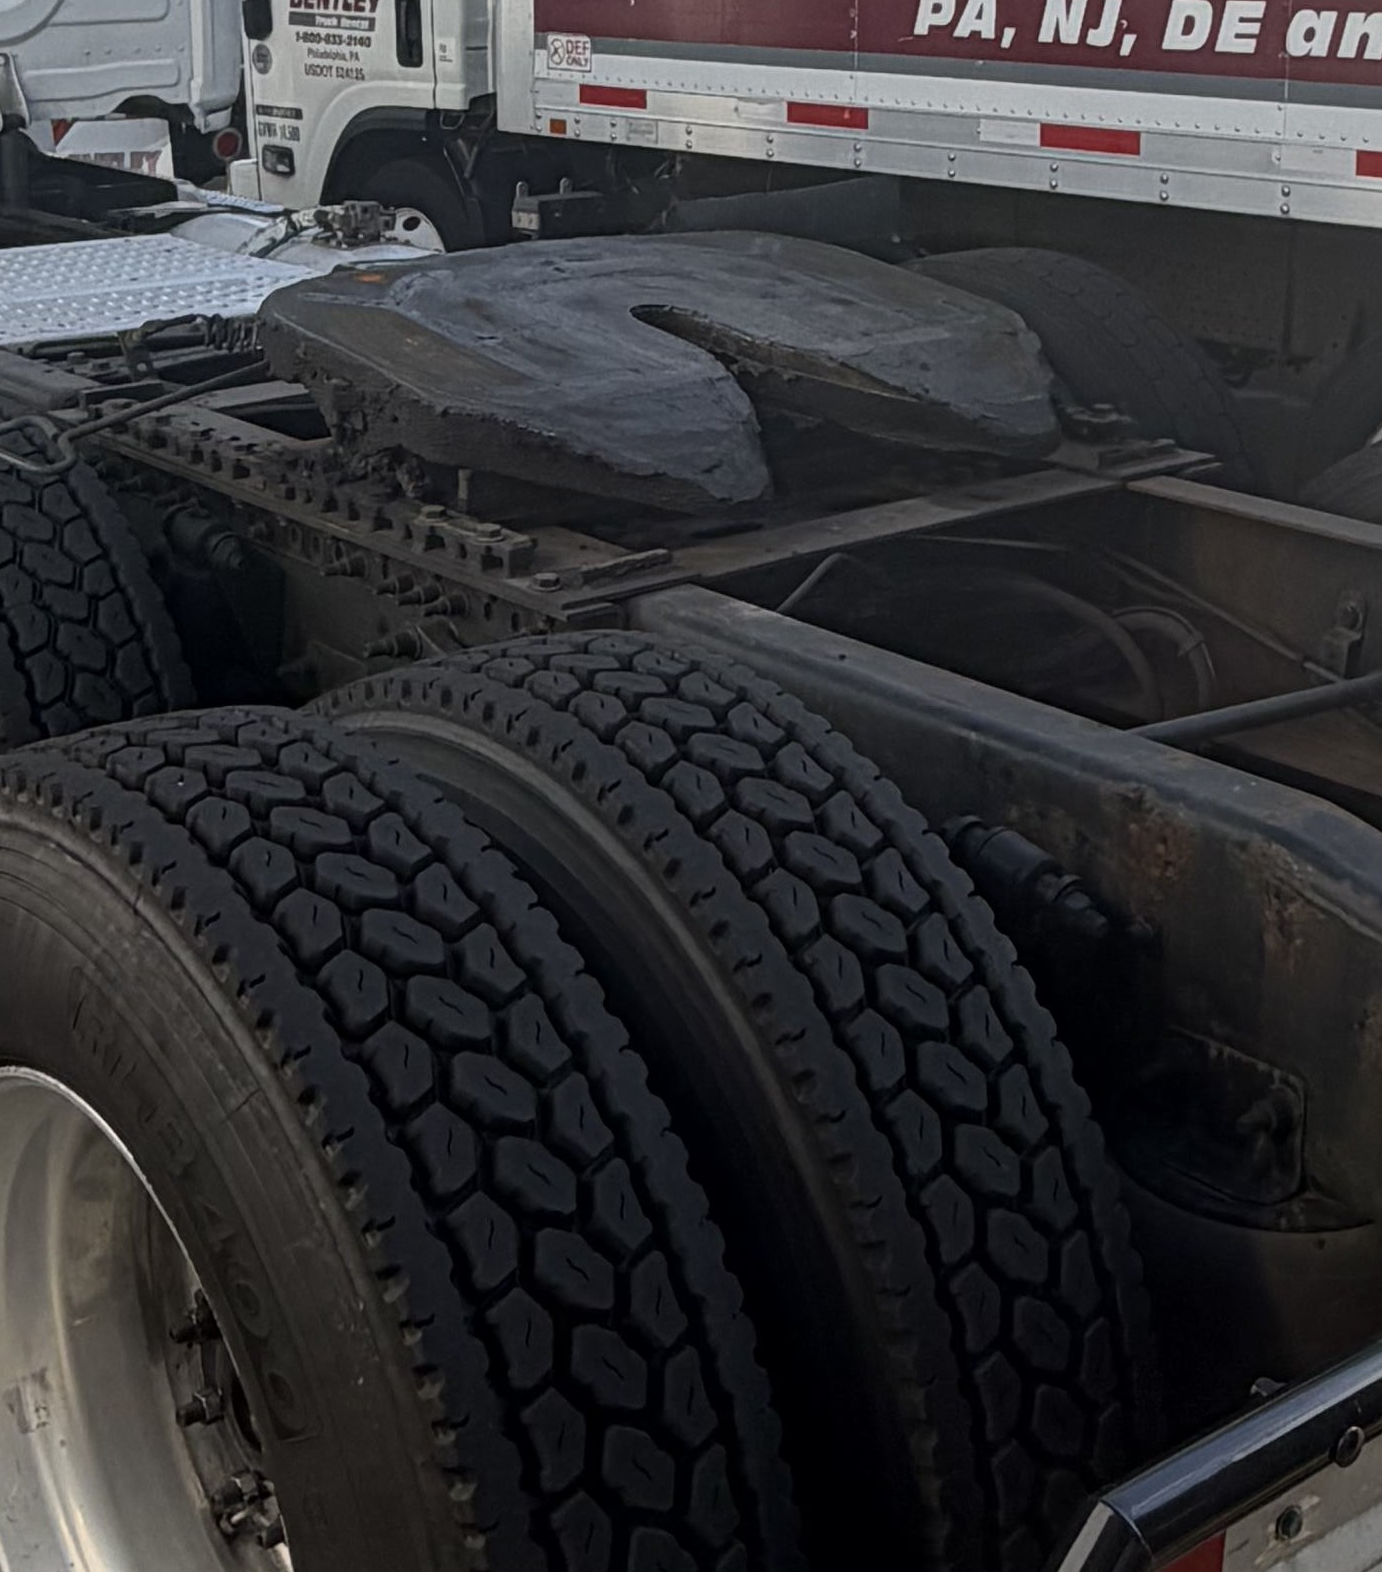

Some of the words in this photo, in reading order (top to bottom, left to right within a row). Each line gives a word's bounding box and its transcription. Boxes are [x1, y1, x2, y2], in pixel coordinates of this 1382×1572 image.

[1161, 0, 1266, 53] DE
[565, 39, 589, 55] DEF
[565, 55, 589, 67] ONLY
